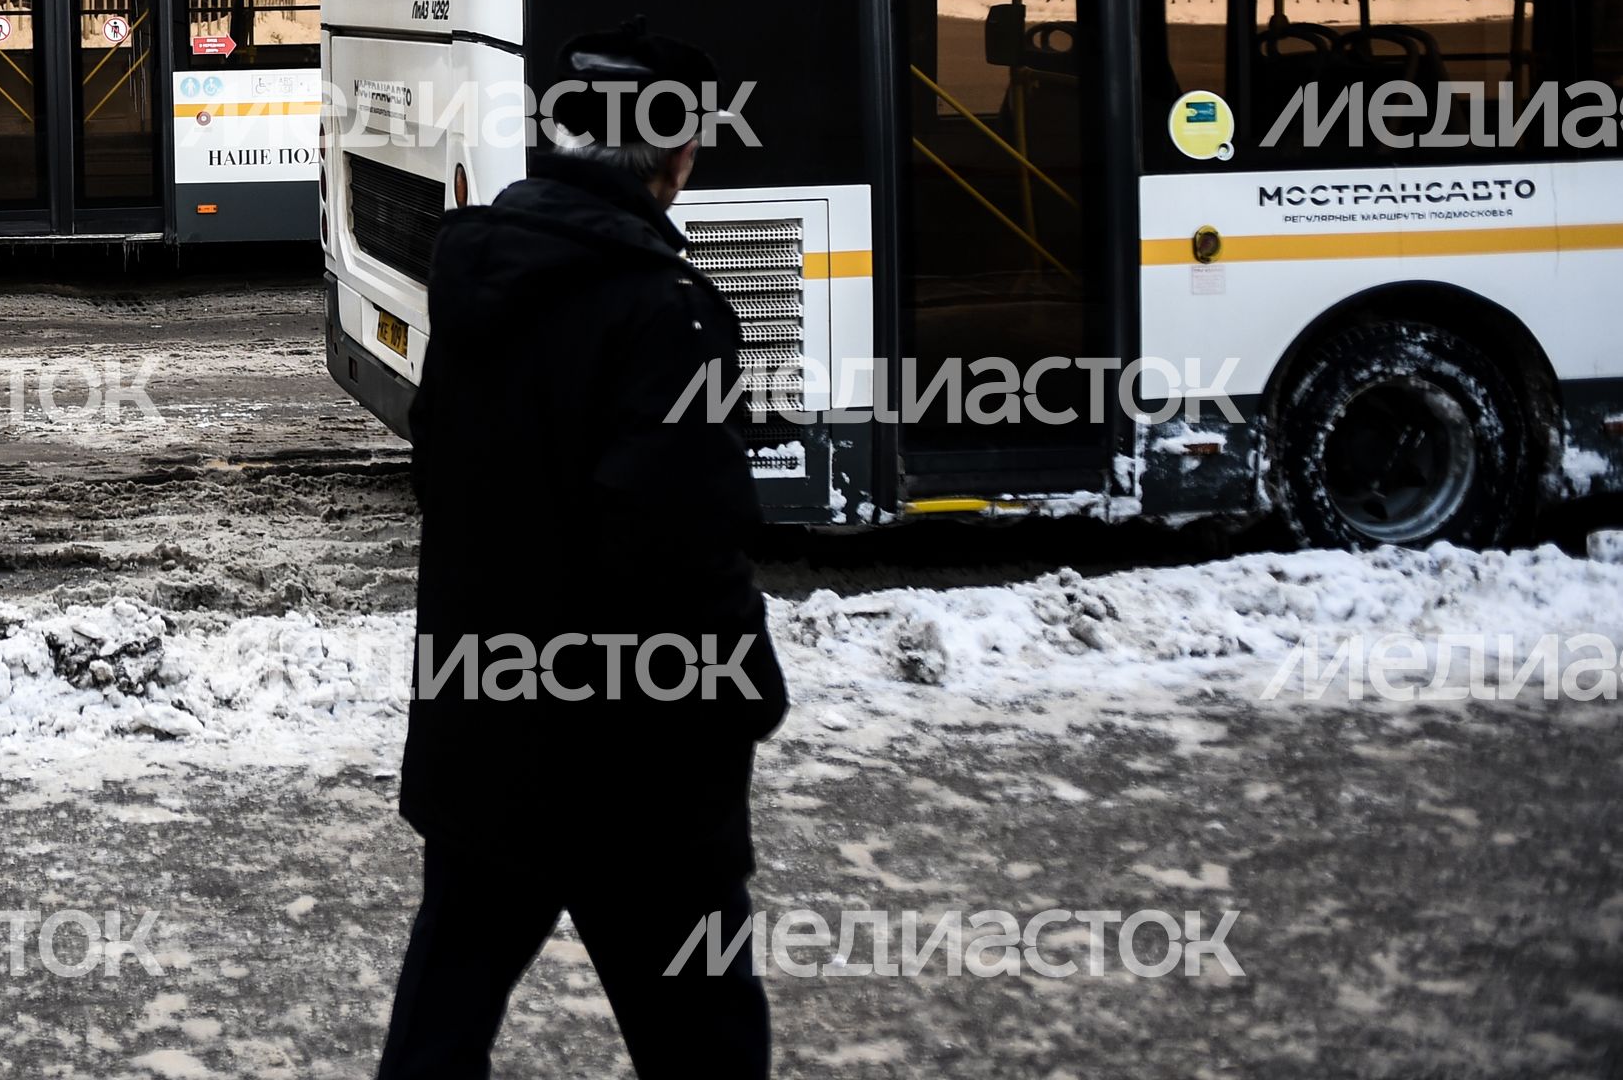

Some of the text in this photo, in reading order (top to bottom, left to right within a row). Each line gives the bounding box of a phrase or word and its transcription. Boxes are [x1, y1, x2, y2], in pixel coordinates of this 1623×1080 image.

[431, 0, 450, 20] 4292
[209, 149, 272, 166] НАШЕ
[1258, 179, 1536, 207] МОСТРАНСАВТО
[1284, 208, 1513, 223] РЕГУЛЯРНЫЕ МАРШРУТЫ ПОДМОСКОВЬЯ
